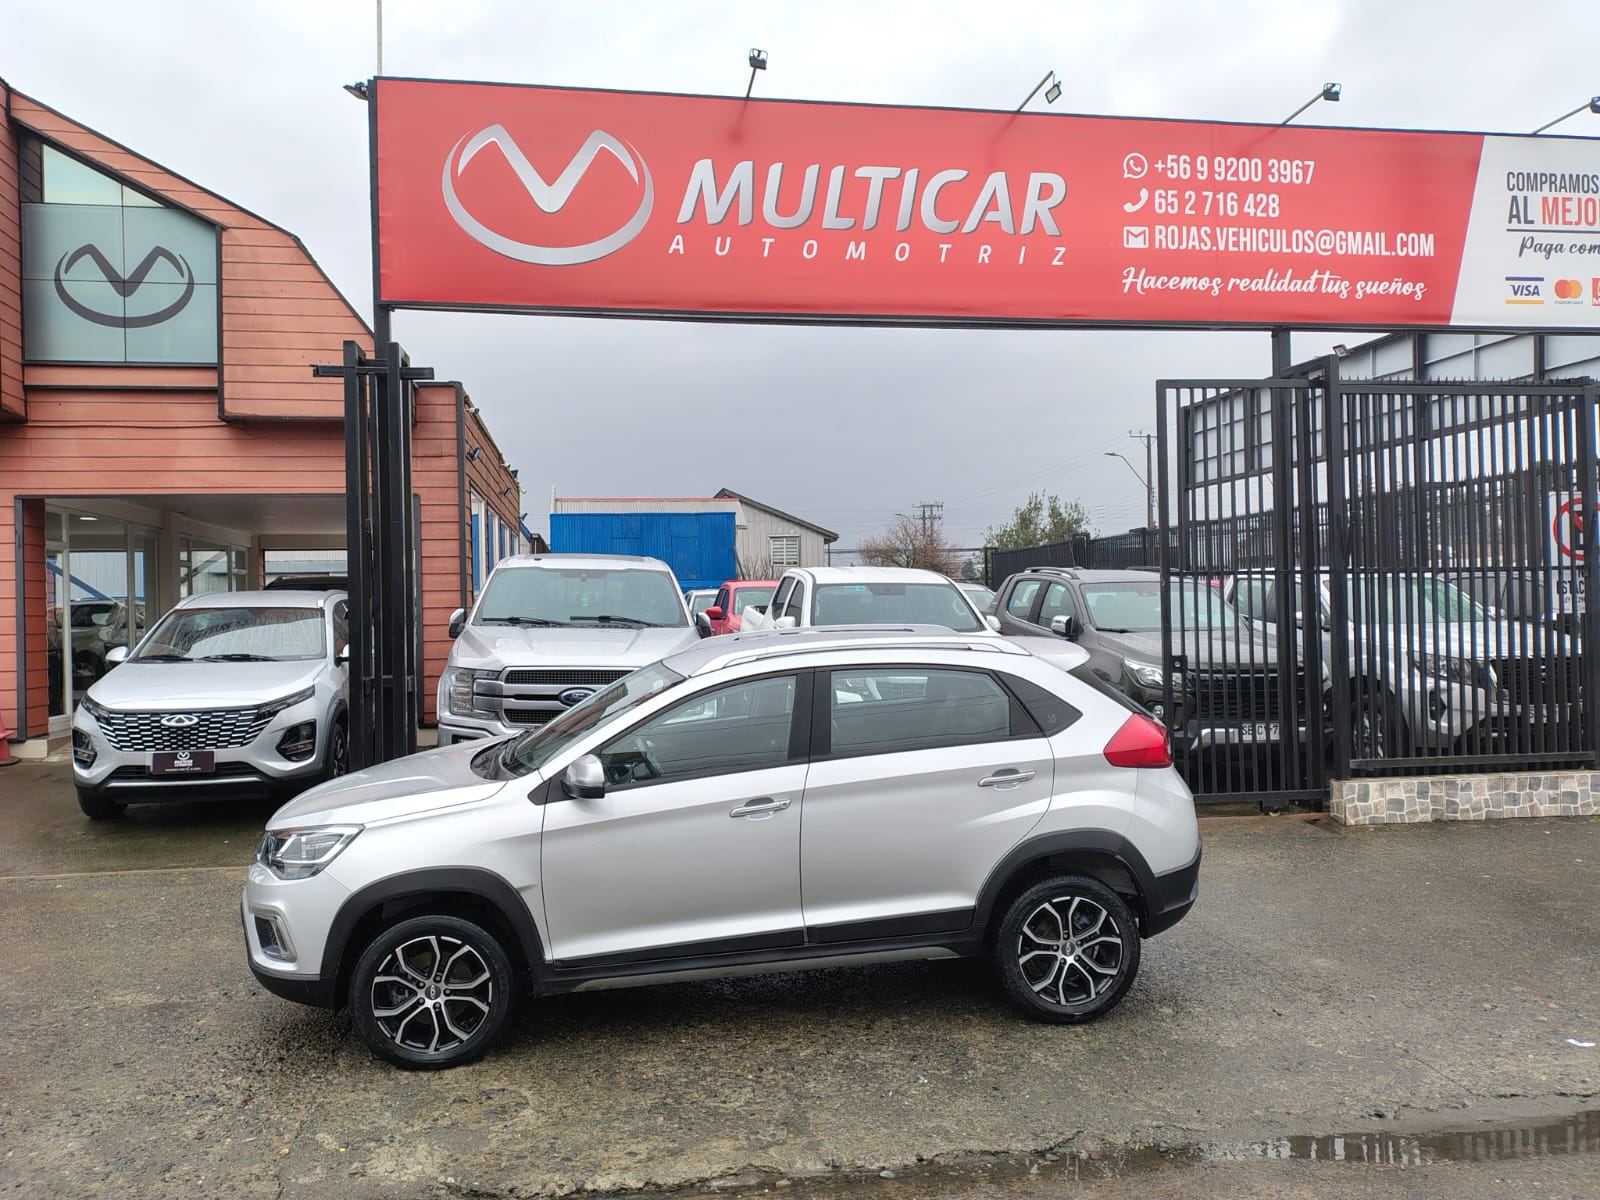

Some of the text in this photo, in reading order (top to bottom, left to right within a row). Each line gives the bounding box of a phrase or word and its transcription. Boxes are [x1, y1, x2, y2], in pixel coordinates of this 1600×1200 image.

[1154, 154, 1315, 185] +56 9 9200 3967
[1506, 171, 1600, 194] COMPRAMOS
[676, 158, 1067, 236] MULTICAR
[1154, 189, 1280, 218] 65 2 716 428
[1507, 195, 1600, 227] AL MEJO
[668, 234, 1067, 266] AUTOMOTRIZ
[1154, 224, 1435, 257] ROJAS.VEHICULOS@GMAIL.COM
[1518, 235, 1566, 260] Paga
[1122, 266, 1428, 301] Hacemos realidad tus sueños
[1510, 284, 1541, 297] VISA
